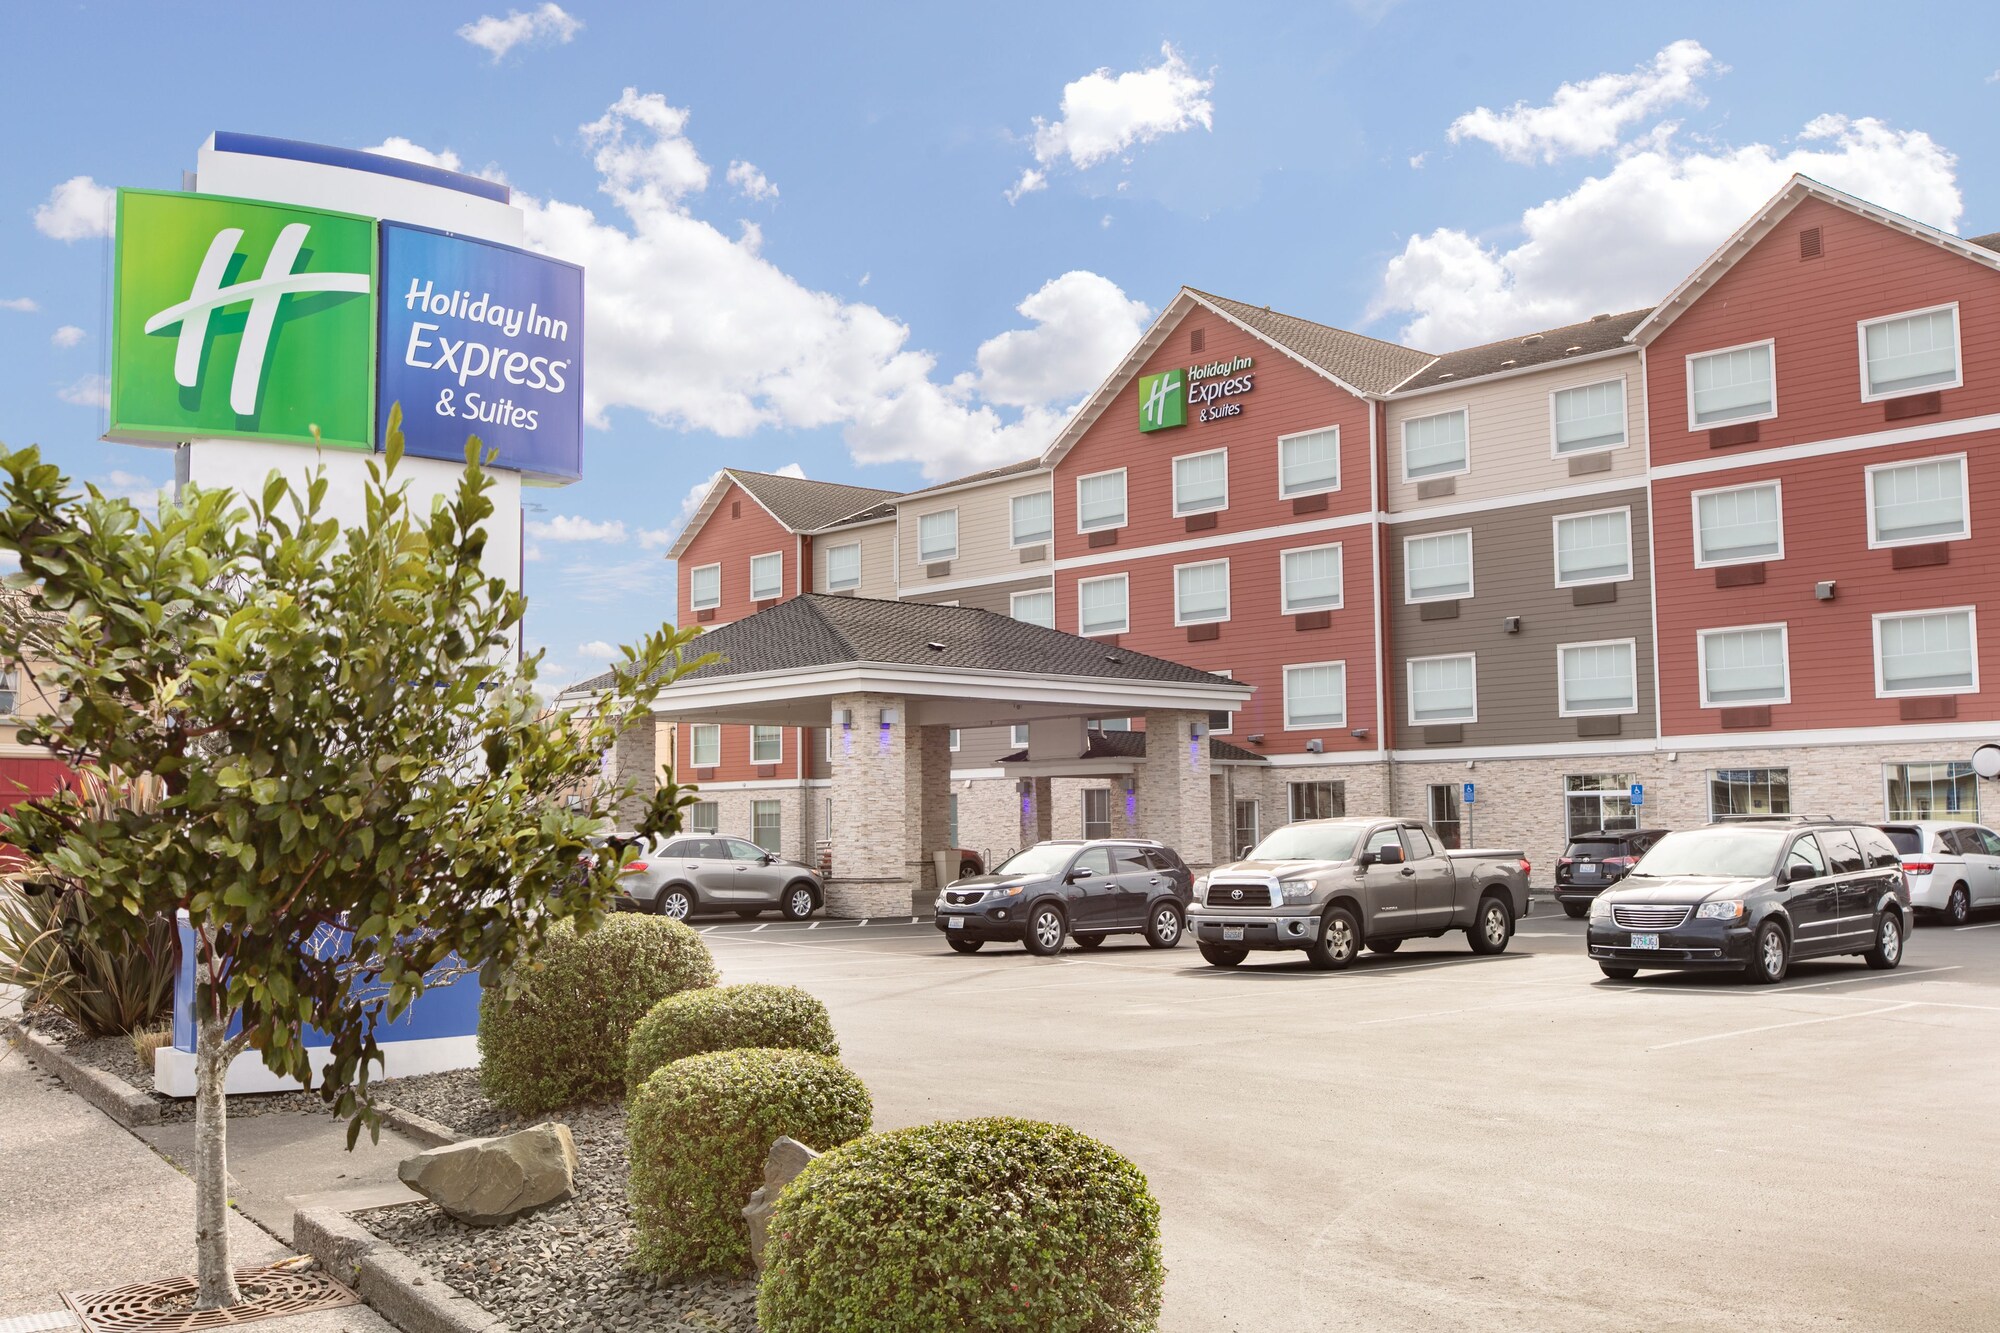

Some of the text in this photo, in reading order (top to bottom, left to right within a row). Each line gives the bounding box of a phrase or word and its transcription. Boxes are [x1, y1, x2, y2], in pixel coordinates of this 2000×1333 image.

[405, 278, 568, 342] Holiday Inn
[405, 322, 569, 394] Express
[1188, 356, 1252, 381] Holiday Inn
[1188, 374, 1252, 405] Express
[435, 388, 539, 431] & Suites
[1199, 403, 1240, 422] & Suites
